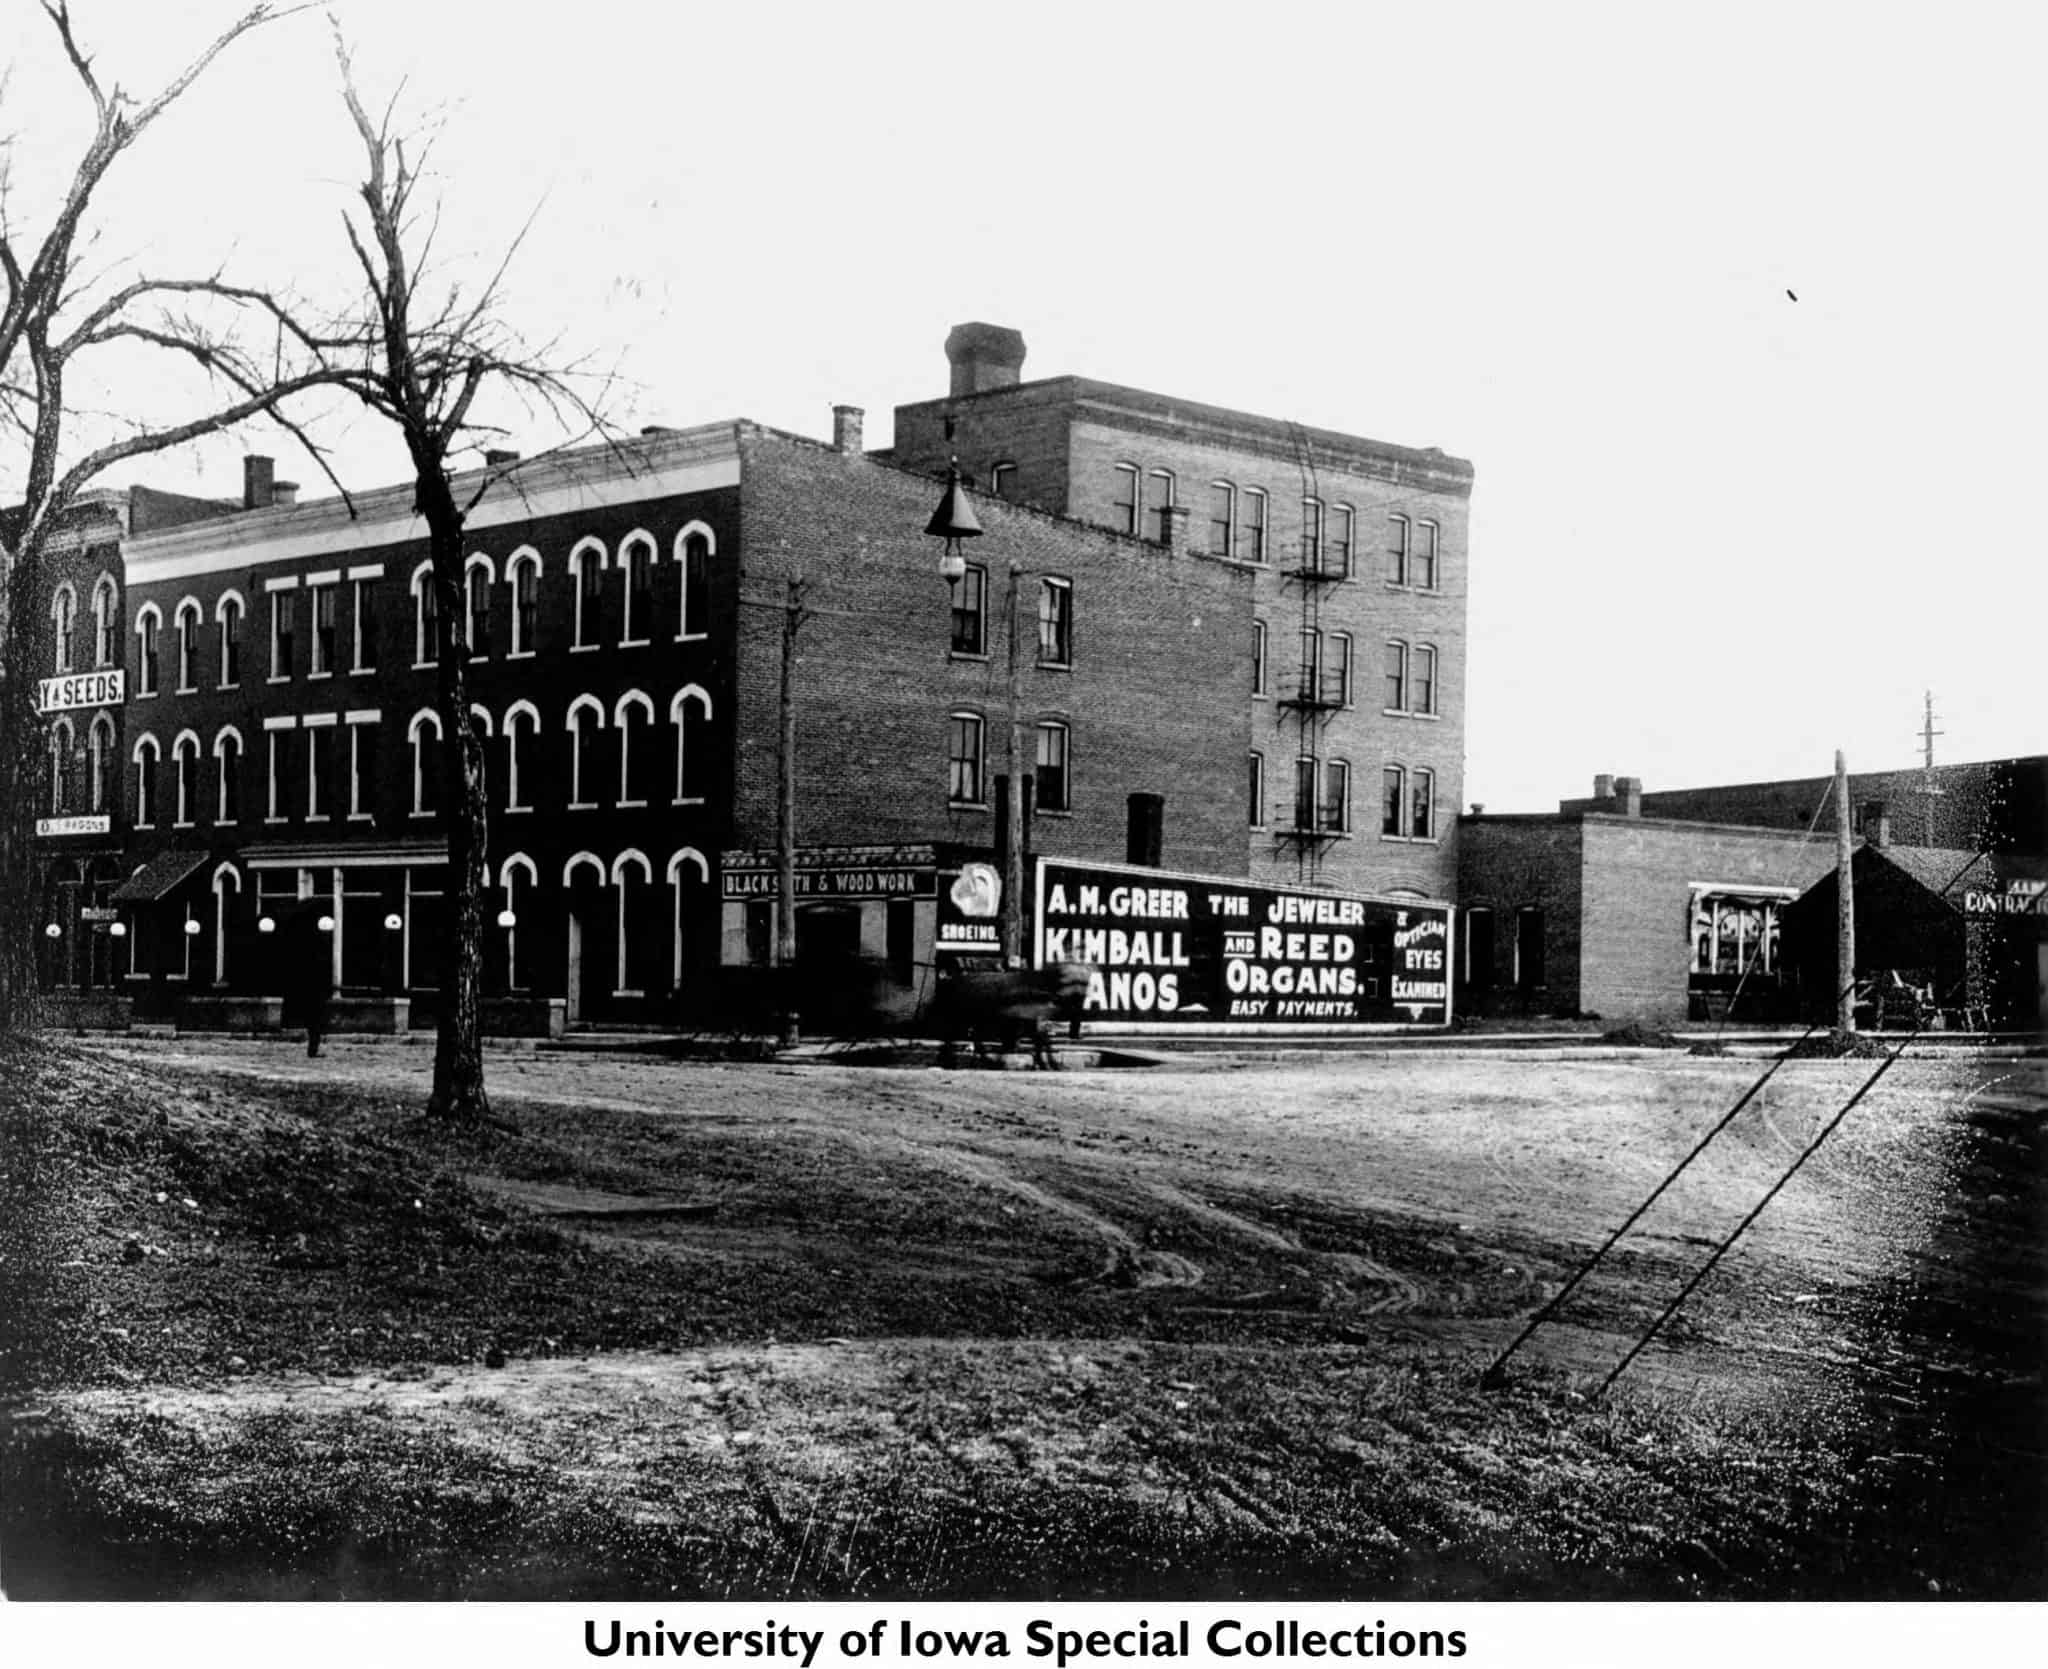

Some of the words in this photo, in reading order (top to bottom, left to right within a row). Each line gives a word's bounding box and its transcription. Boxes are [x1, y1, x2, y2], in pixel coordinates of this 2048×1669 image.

[64, 674, 122, 704] SEEDS.
[726, 875, 810, 893] BLACKSTH
[818, 874, 828, 892] &
[836, 873, 874, 892] WOOD
[877, 873, 915, 892] WORK
[1208, 895, 1249, 916] THE
[1268, 896, 1365, 925] JEWELER
[1046, 927, 1190, 966] KIMBALL
[1225, 937, 1255, 953] AND
[1261, 926, 1355, 962] REED
[1394, 920, 1447, 948] OPTICIAN
[1405, 949, 1443, 970] EYES
[1083, 971, 1179, 1011] ANOS
[1226, 958, 1365, 995] ORGANS.
[1391, 974, 1446, 999] EXAMINED
[1230, 1000, 1269, 1015] EASY
[1276, 1001, 1359, 1016] PAYMENTS.
